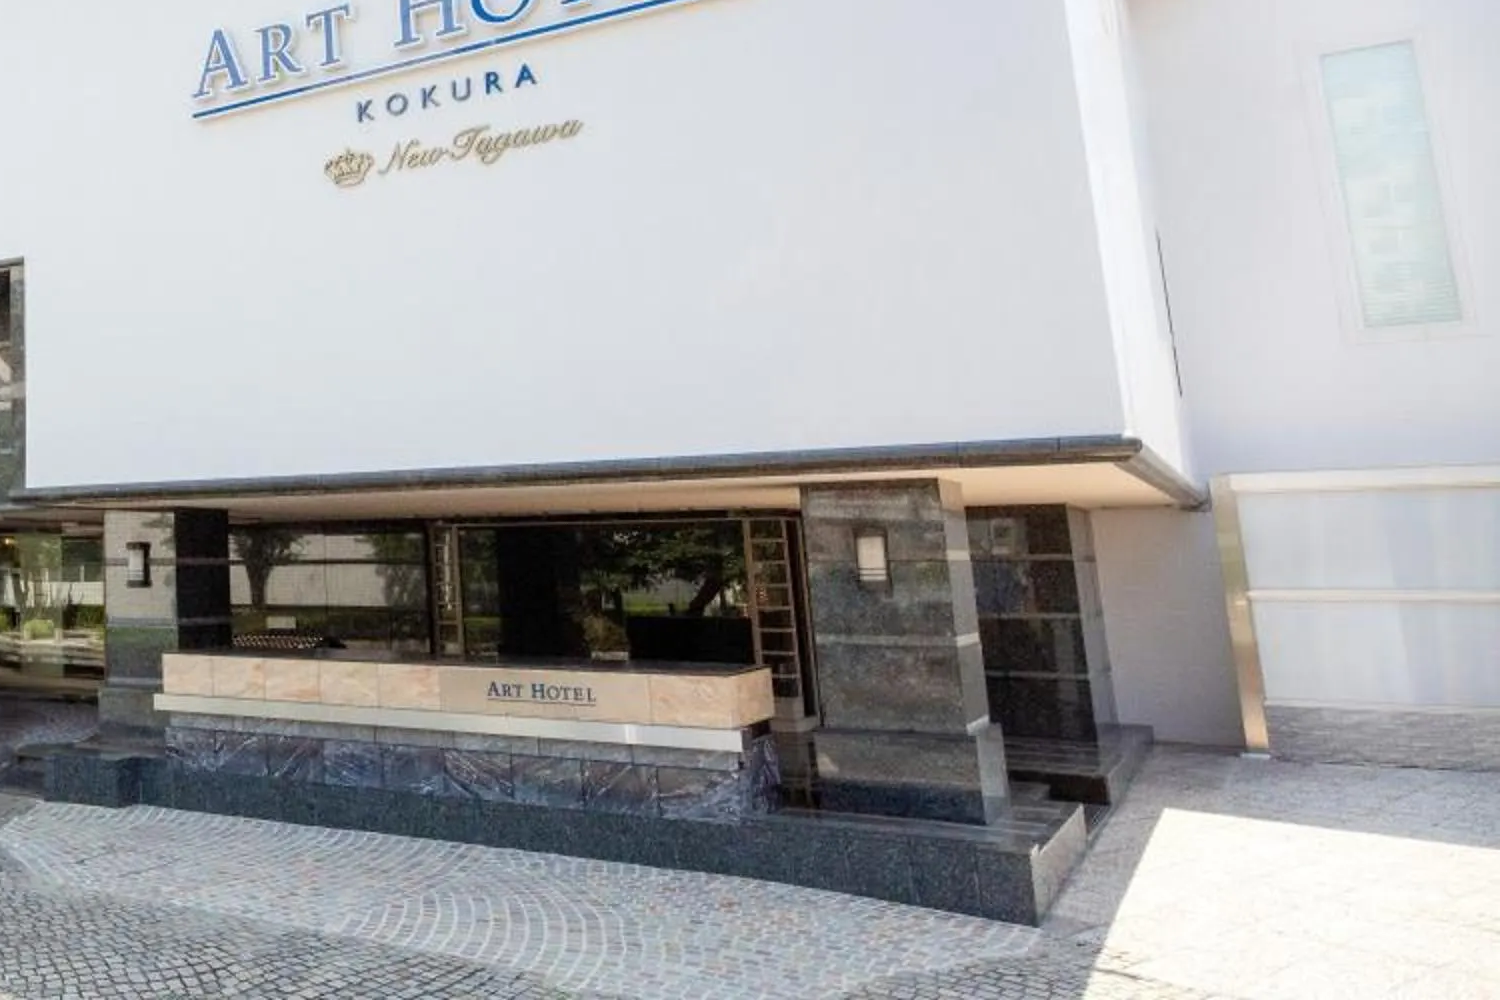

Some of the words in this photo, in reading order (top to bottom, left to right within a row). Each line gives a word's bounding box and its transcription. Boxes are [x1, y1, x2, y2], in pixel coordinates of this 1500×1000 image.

[191, 3, 352, 99] ART
[356, 62, 538, 123] KOKURA
[487, 680, 524, 698] ART
[531, 683, 597, 703] HOTEL
